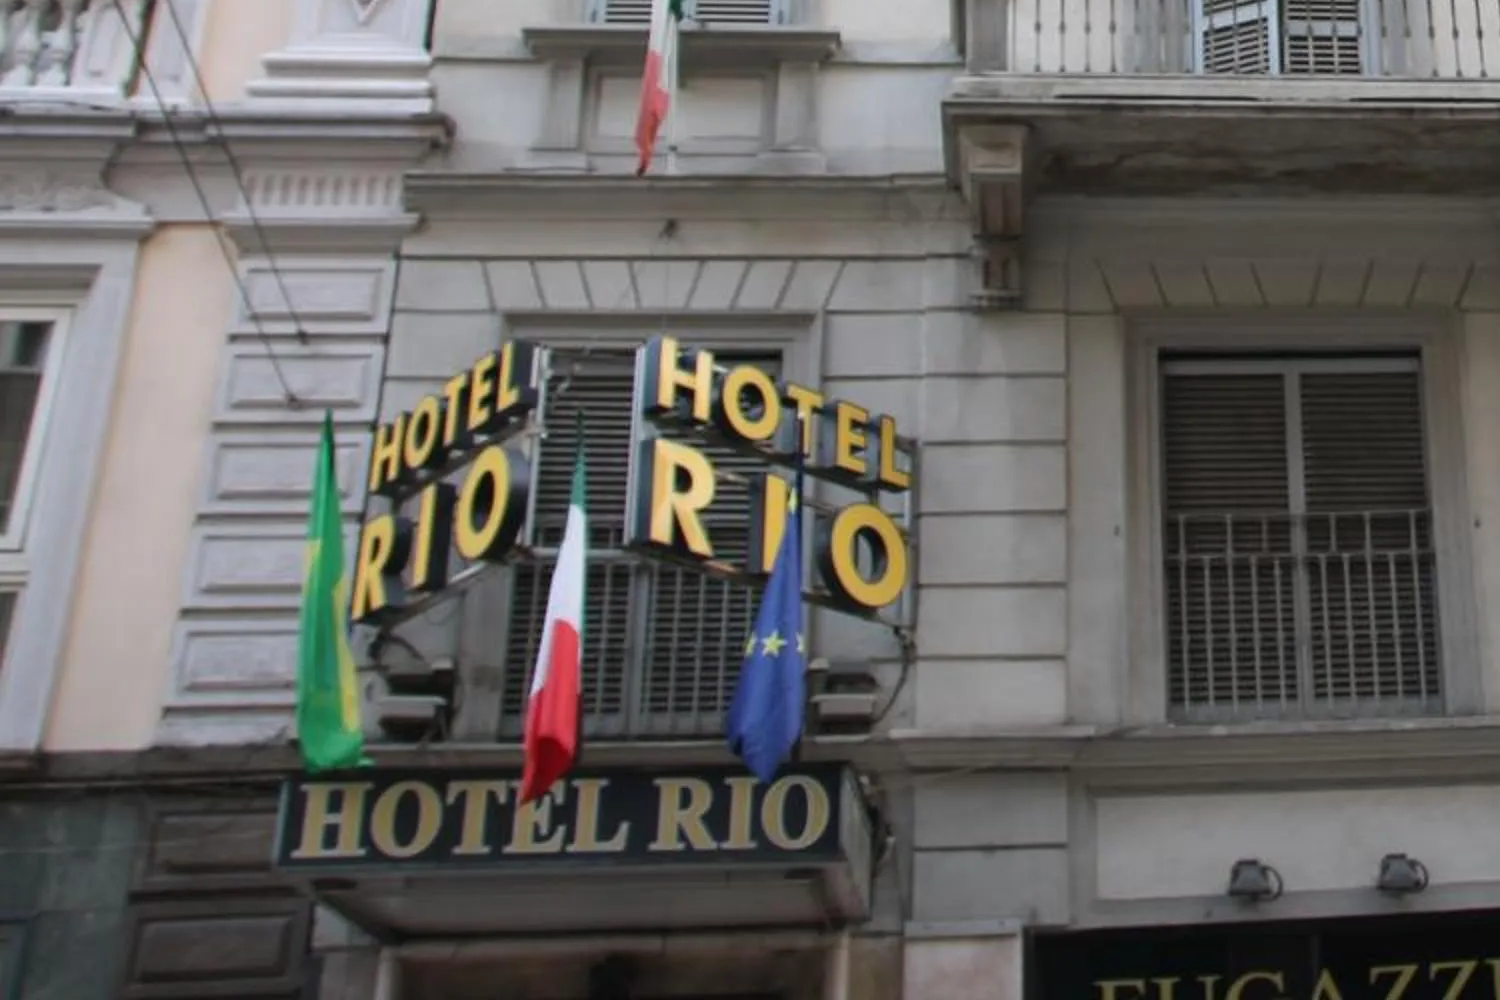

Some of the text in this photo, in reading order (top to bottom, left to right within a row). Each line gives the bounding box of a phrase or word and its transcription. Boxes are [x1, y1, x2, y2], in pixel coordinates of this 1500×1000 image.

[370, 341, 519, 489] HOTEL
[657, 336, 911, 488] HOTEL
[352, 446, 509, 620] RIO
[651, 438, 907, 608] RIO
[292, 775, 829, 858] HOTEL RIO
